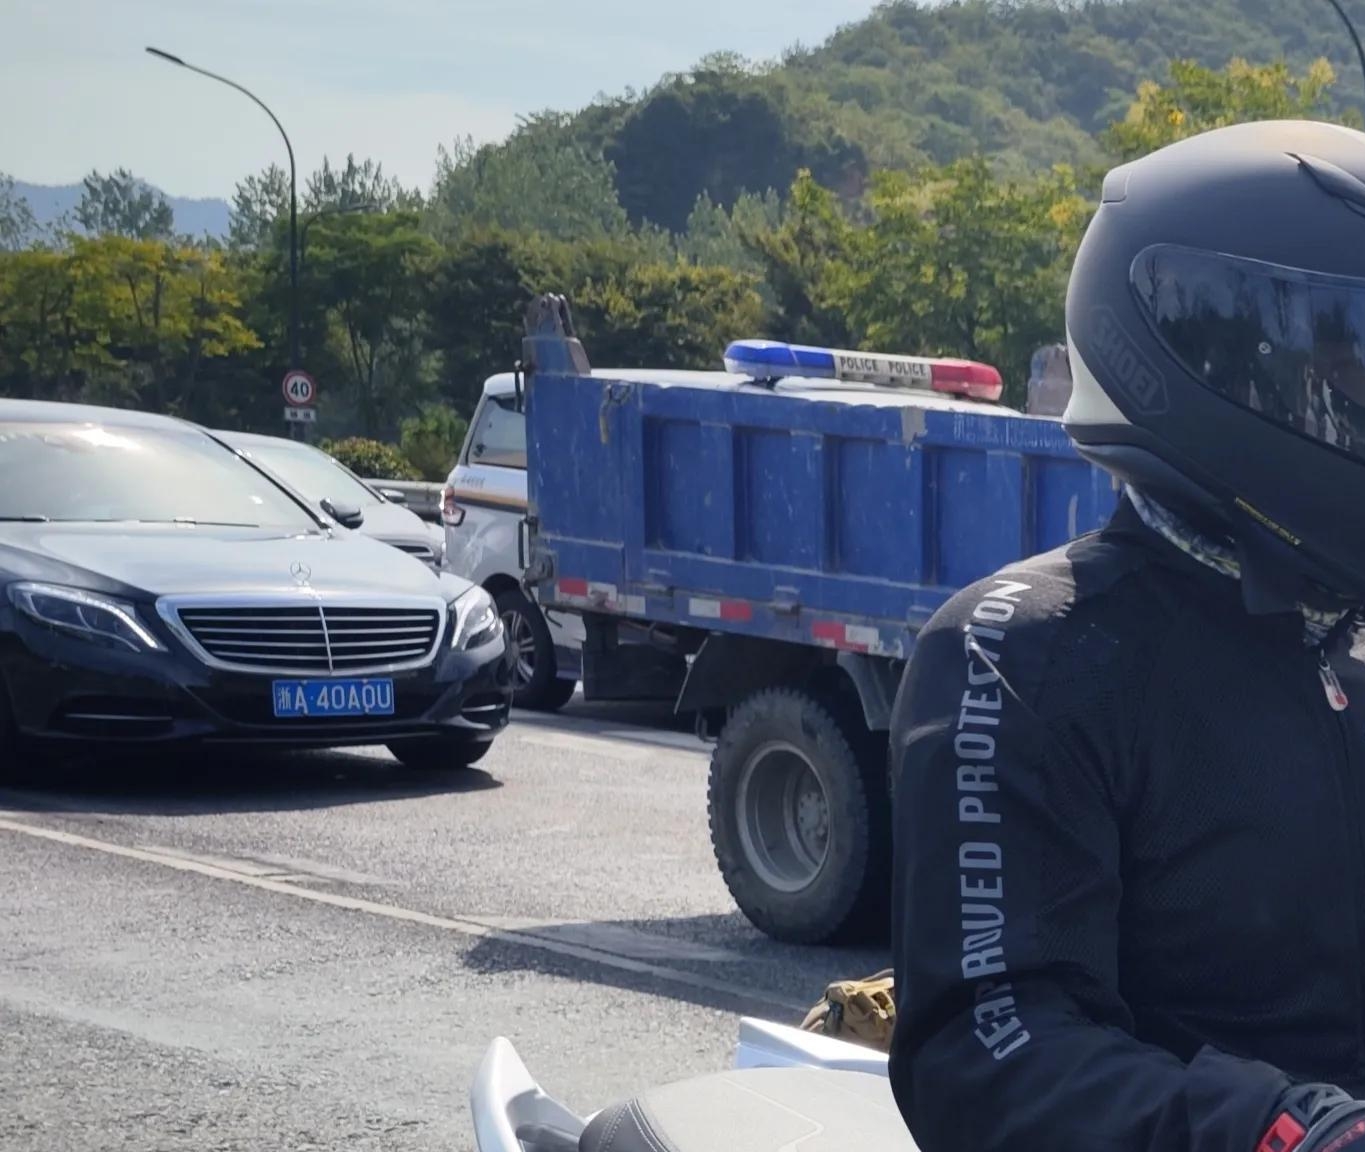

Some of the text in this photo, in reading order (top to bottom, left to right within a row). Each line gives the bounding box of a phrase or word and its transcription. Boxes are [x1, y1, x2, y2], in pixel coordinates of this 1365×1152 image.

[291, 381, 309, 397] 40
[839, 356, 926, 376] POLICE POLICE
[1091, 316, 1159, 407] SHOEI
[954, 579, 1033, 824] PROTECTION
